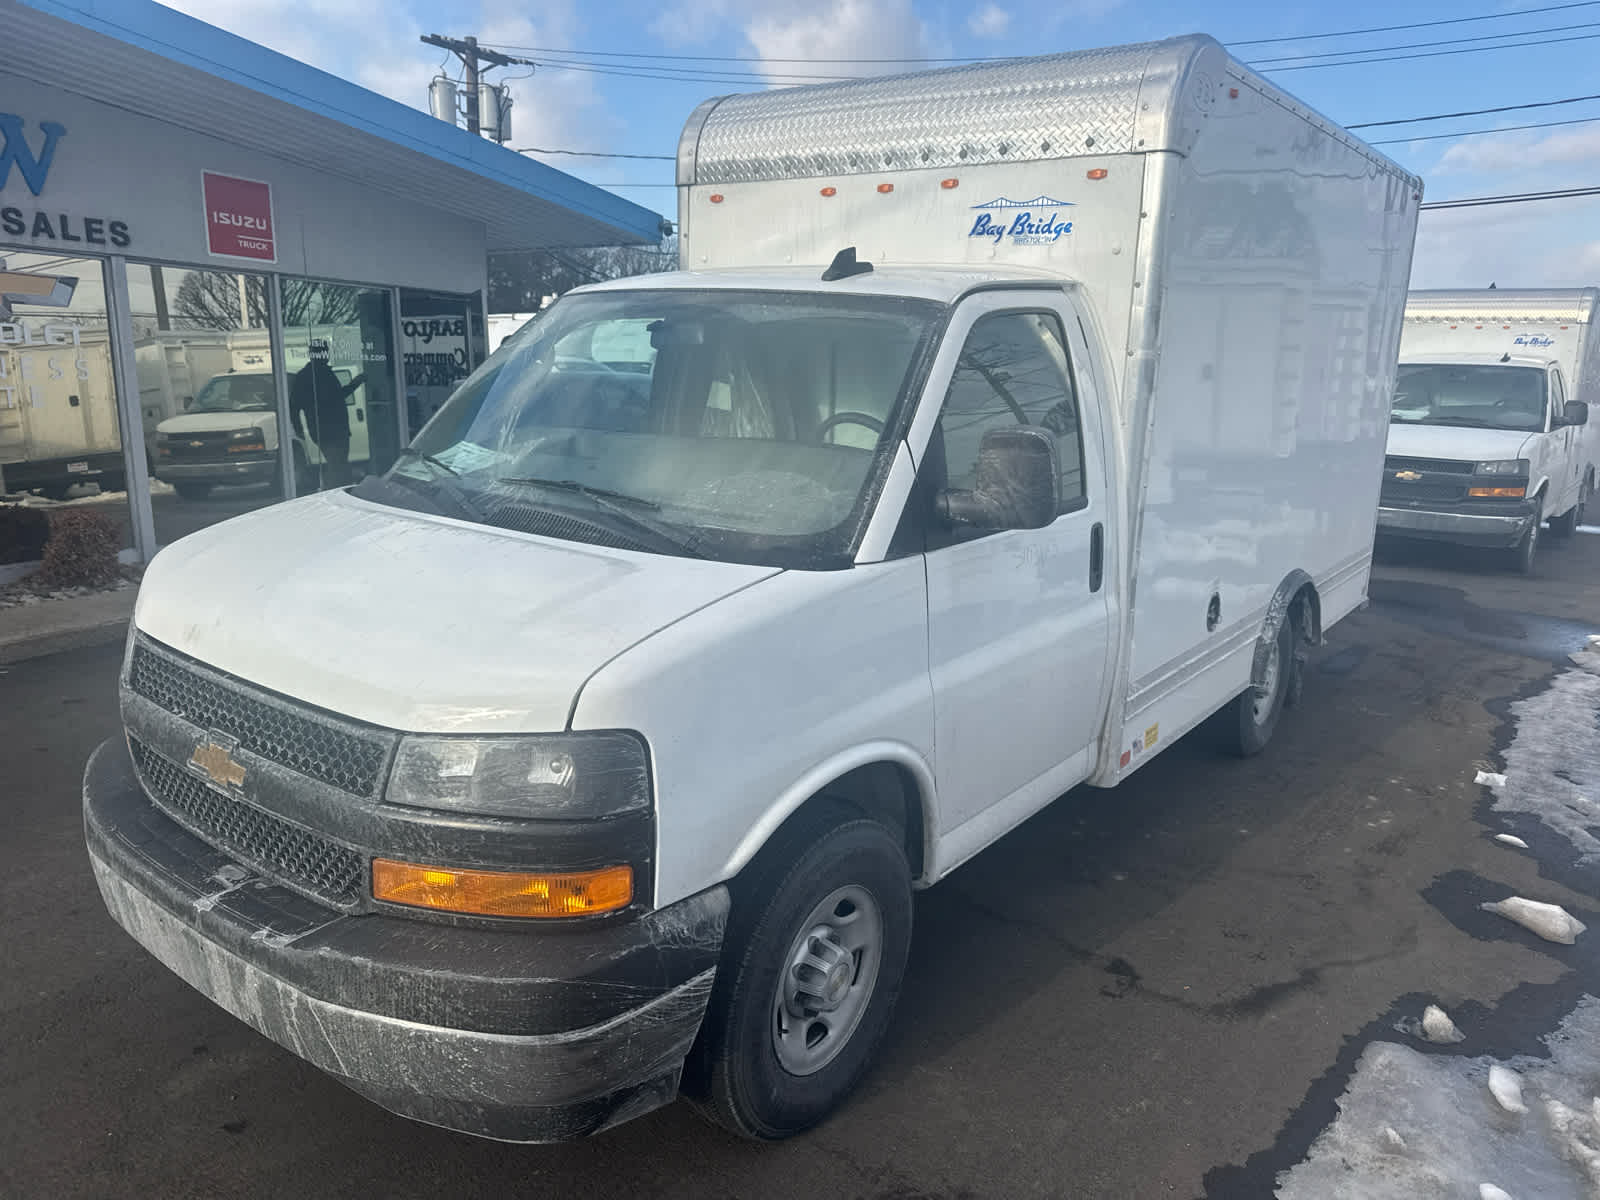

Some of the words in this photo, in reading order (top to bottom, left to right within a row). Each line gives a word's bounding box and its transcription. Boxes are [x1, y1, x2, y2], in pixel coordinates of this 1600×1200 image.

[1, 207, 131, 247] SALES
[213, 211, 267, 231] ISUZU
[968, 212, 1006, 244] Bay
[1007, 211, 1073, 242] Bridge
[237, 239, 268, 251] TRUCK
